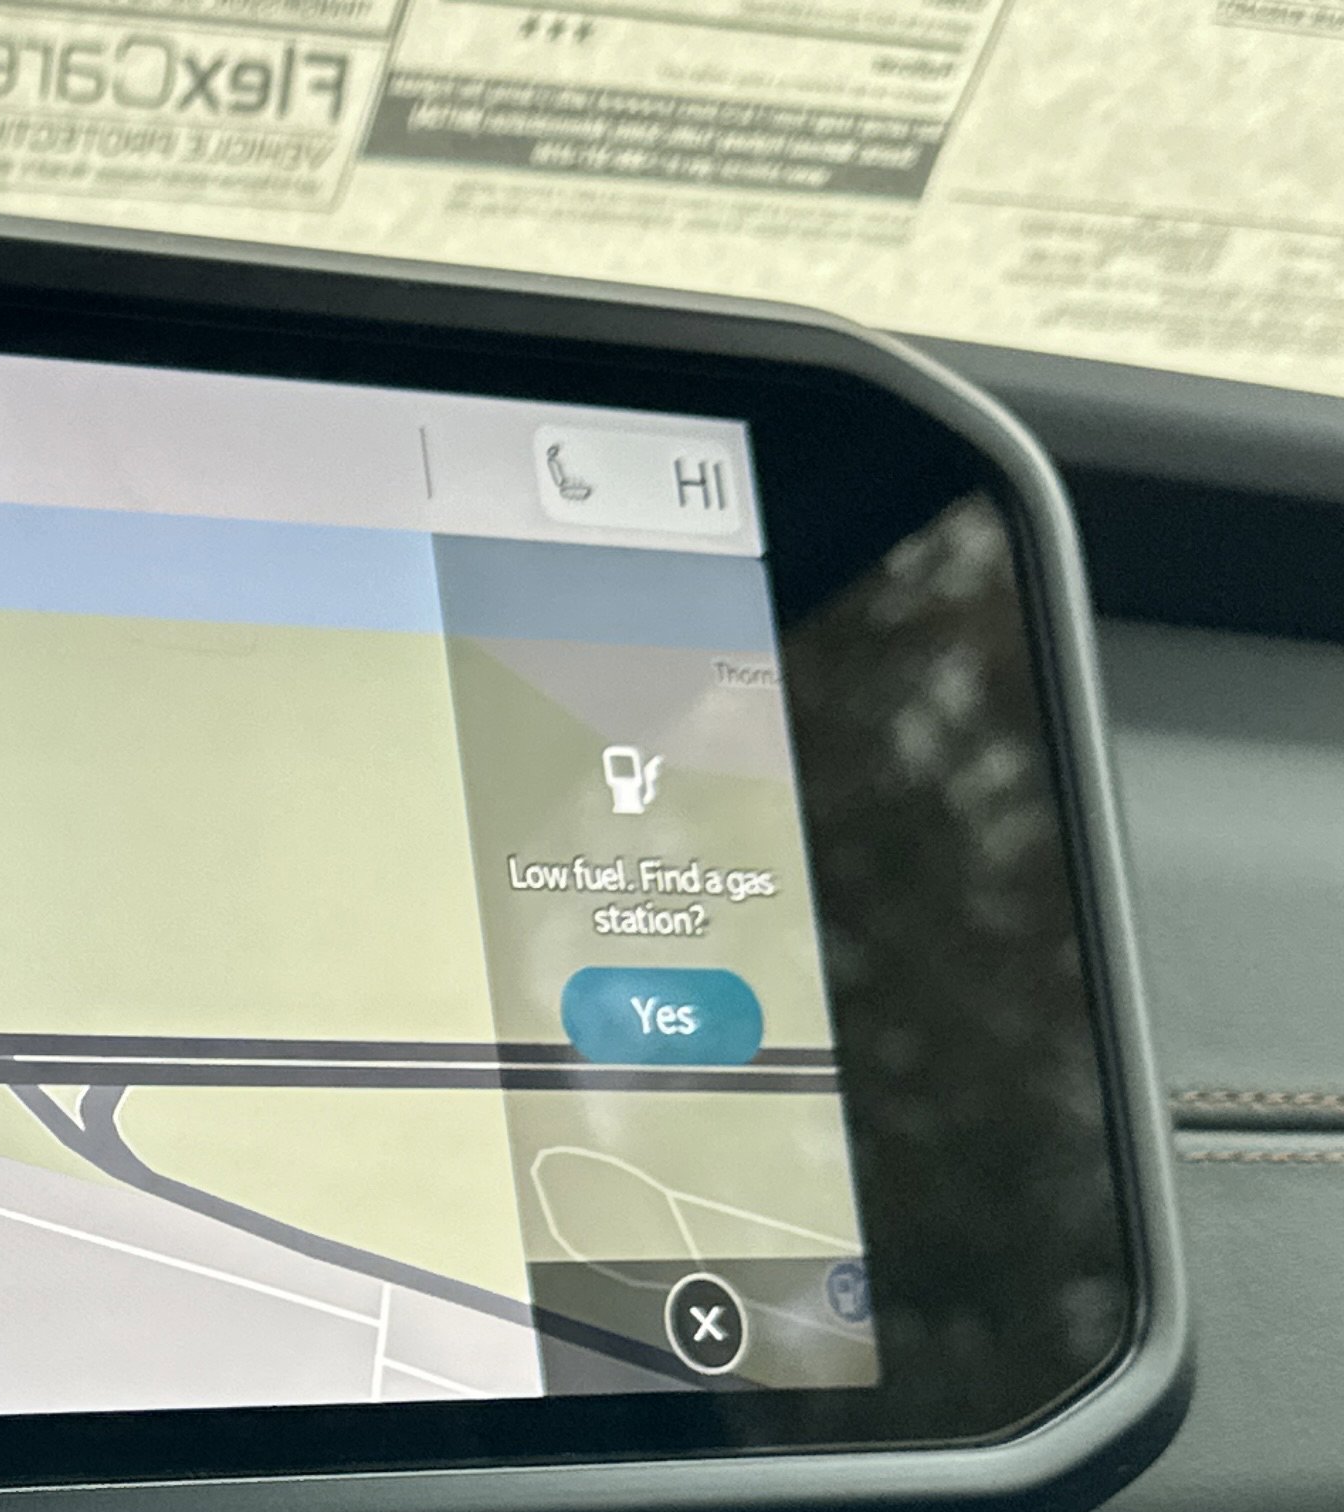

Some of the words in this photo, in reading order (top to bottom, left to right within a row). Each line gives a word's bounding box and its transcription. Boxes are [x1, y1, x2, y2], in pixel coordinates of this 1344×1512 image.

[673, 457, 728, 513] HI
[508, 857, 568, 890] Low
[573, 858, 634, 892] fuel.
[639, 859, 701, 894] Find
[705, 871, 723, 894] a
[726, 871, 775, 902] gas
[593, 903, 707, 935] station?
[629, 996, 698, 1036] Yes
